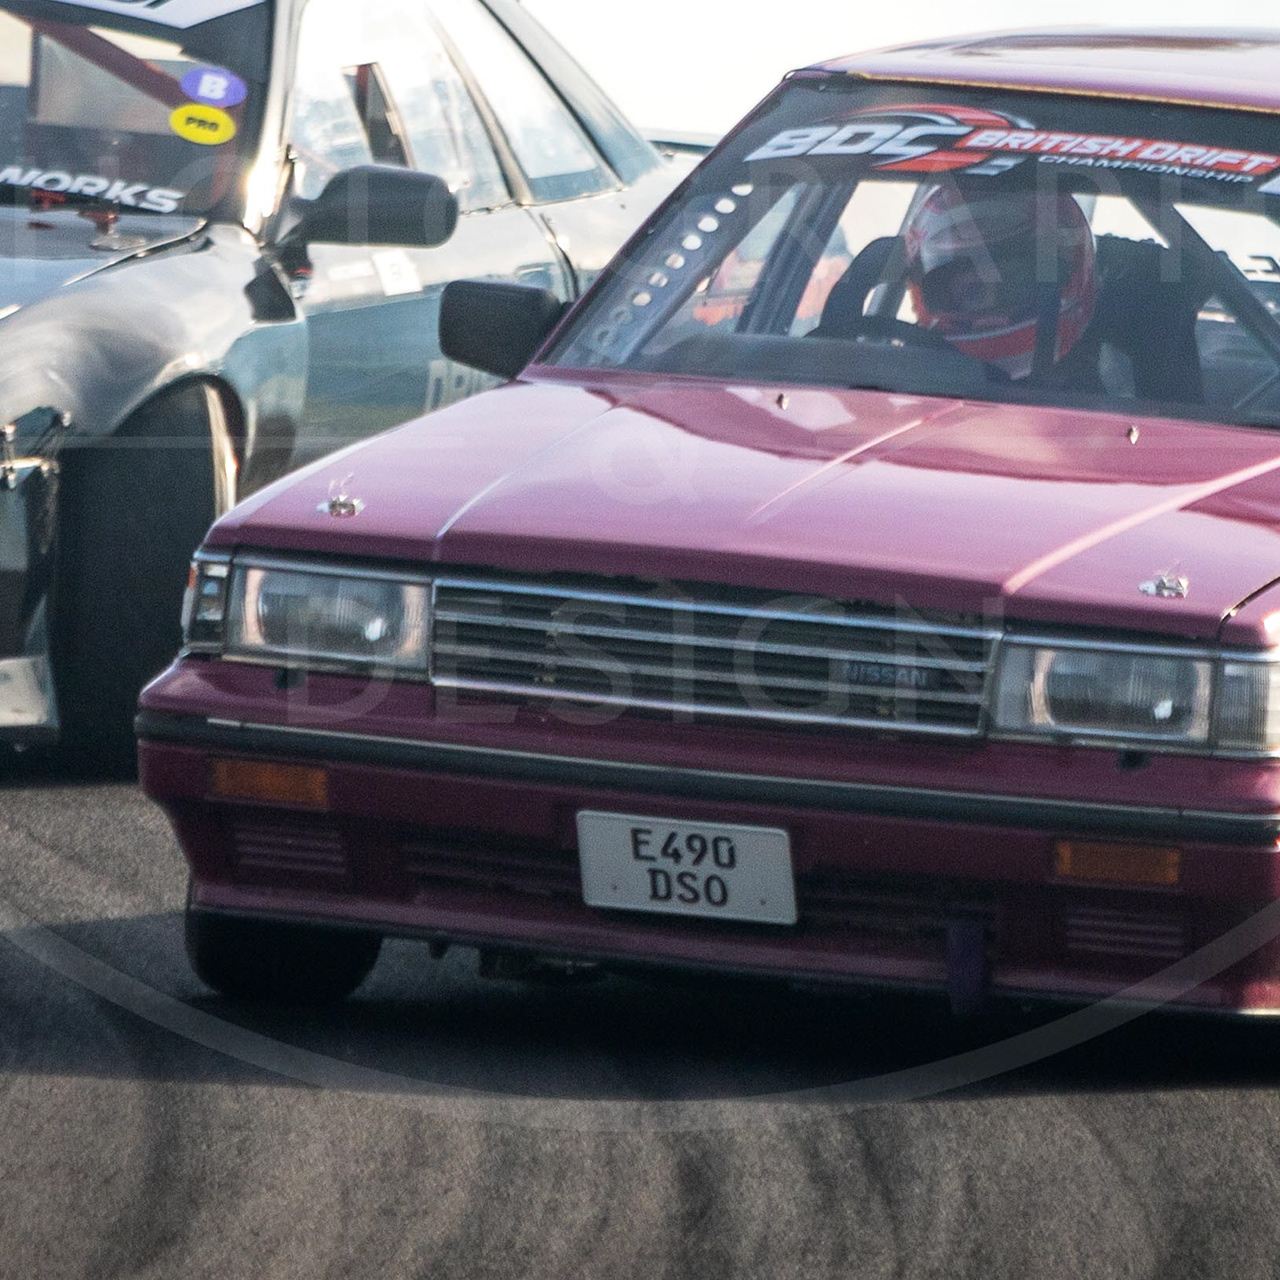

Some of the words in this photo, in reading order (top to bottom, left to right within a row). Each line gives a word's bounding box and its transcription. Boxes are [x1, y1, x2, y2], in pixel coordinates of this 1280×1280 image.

[197, 73, 229, 101] B
[743, 122, 975, 163] BDC
[966, 128, 1144, 160] BRITISH
[1037, 154, 1255, 184] CHAMPIONSHIP
[840, 660, 927, 686] NISSAN
[630, 827, 737, 870] E490
[647, 867, 729, 908] DSO
